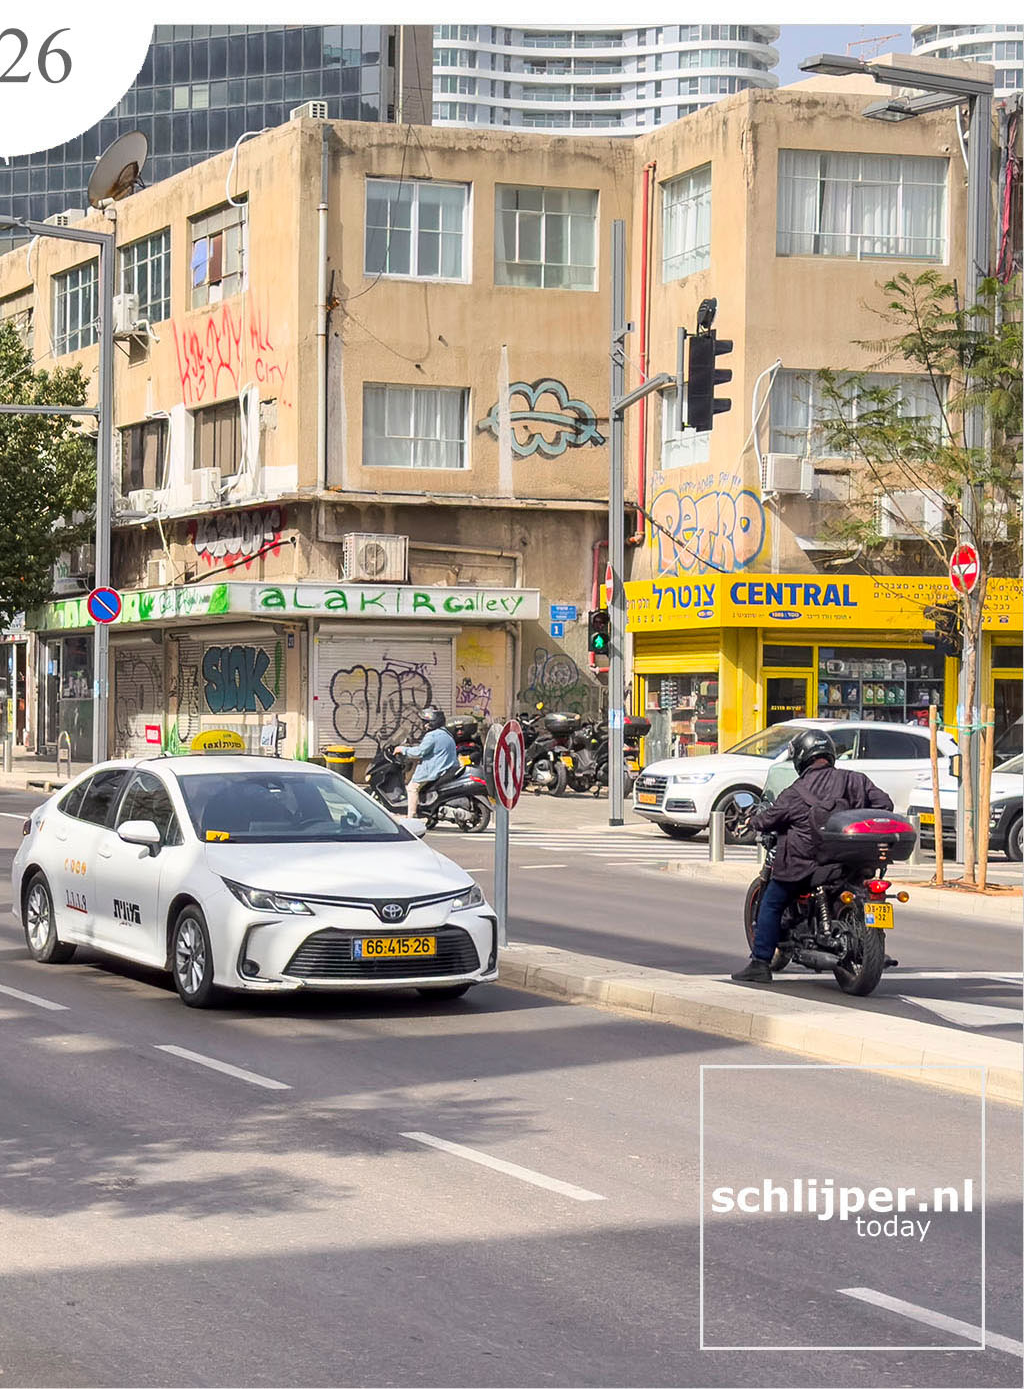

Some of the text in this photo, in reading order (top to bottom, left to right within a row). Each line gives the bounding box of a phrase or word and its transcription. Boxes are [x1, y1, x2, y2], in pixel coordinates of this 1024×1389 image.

[652, 583, 716, 610] צנטרל
[729, 582, 858, 607] CENTRAL
[554, 626, 559, 634] 1
